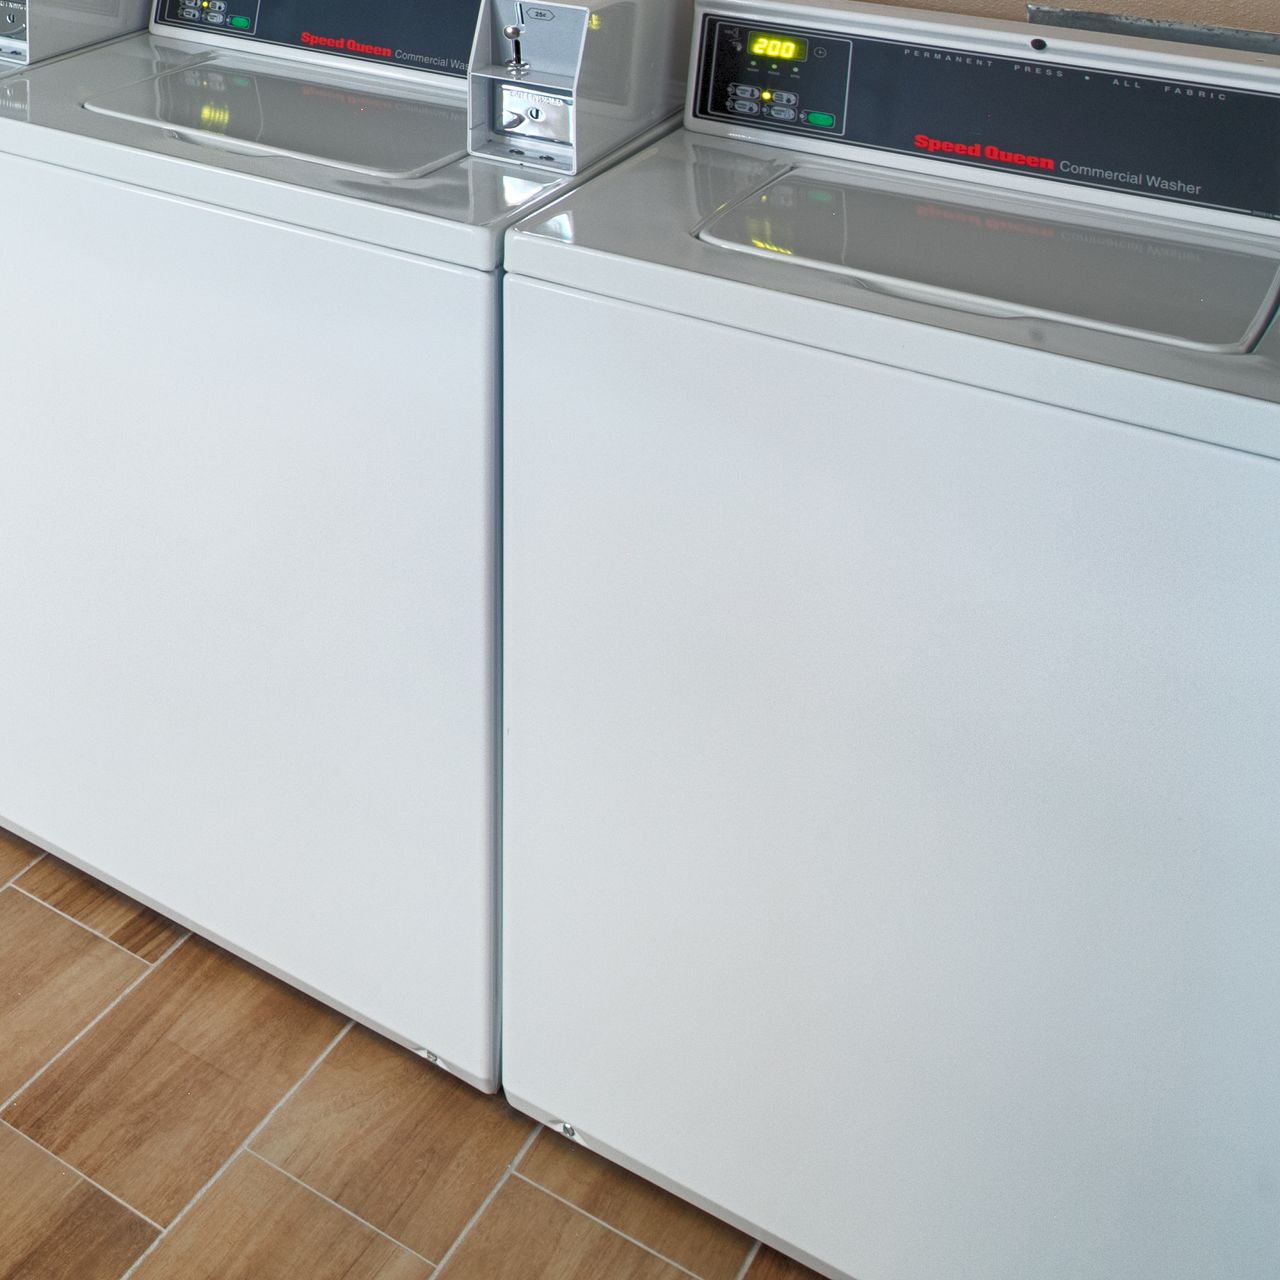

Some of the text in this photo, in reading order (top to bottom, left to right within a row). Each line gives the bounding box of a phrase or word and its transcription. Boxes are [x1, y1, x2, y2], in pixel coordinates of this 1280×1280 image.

[300, 31, 345, 47] Speed
[346, 39, 392, 58] Queen
[394, 49, 449, 67] Commercial
[753, 37, 795, 58] 200
[904, 48, 1227, 101] PERMANENT PRESS ALL FABRIC
[914, 134, 1202, 195] Speed Queen Commercial Washer
